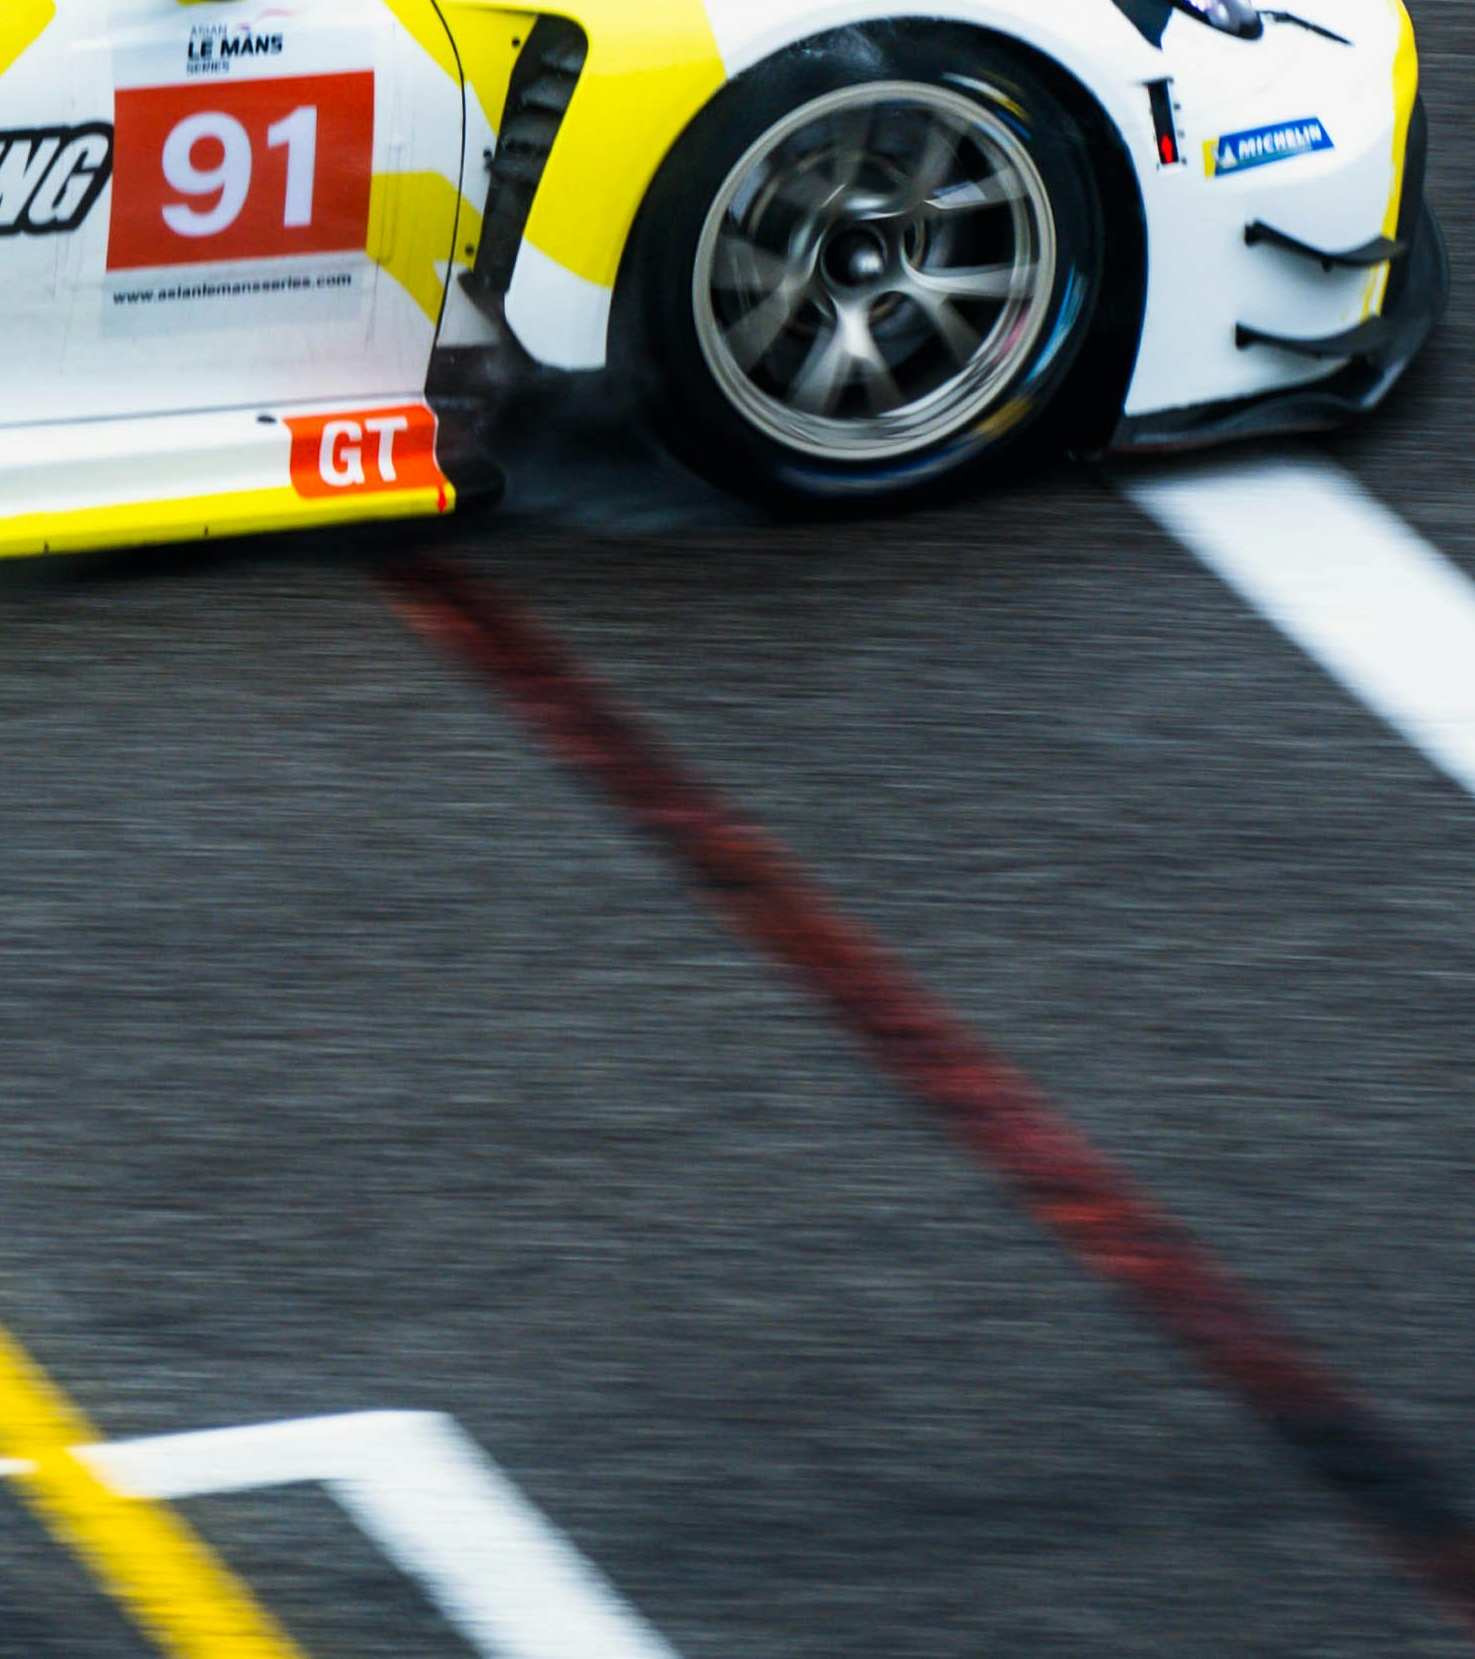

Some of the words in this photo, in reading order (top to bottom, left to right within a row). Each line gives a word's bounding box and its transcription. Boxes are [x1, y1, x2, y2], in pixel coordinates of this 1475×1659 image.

[187, 39, 214, 59] LE
[219, 32, 284, 58] MANS
[1238, 123, 1323, 161] MICHELIN
[160, 104, 318, 239] 91
[112, 273, 353, 305] www.asianlemansseries.com
[317, 415, 409, 488] GT
